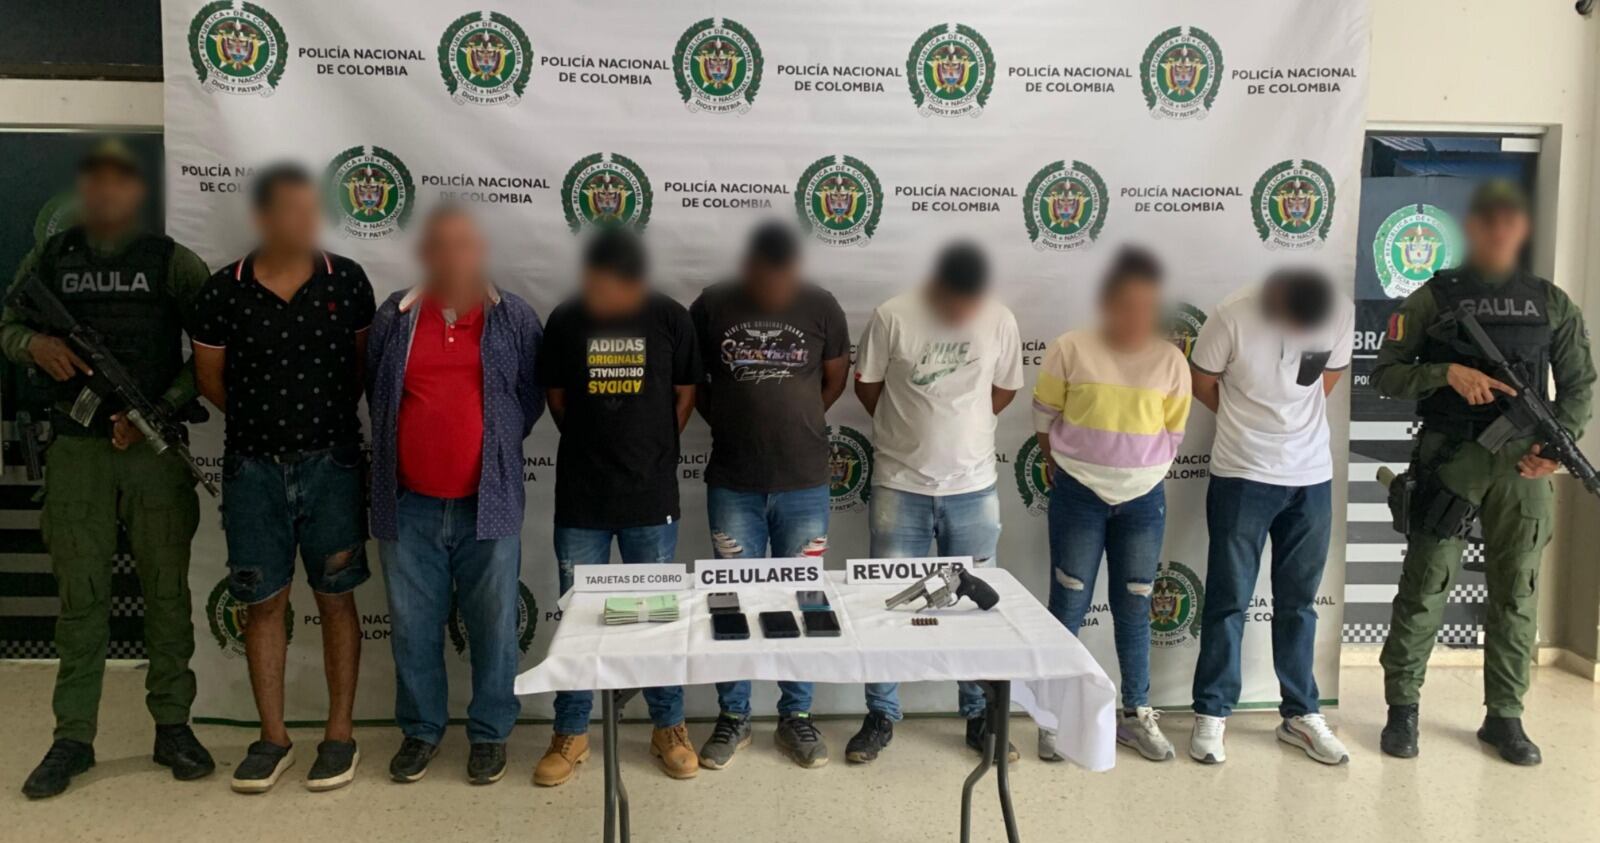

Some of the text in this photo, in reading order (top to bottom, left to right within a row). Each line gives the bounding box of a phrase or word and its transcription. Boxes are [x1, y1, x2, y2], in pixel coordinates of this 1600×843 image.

[200, 12, 225, 50] REPUBLICA
[252, 17, 276, 57] COLOMBIA
[450, 24, 474, 61] REPUBLICA
[500, 26, 521, 64] COLOMBIA
[299, 45, 425, 60] POLICÍA NACIONAL
[684, 32, 707, 70] REPUBLICA
[731, 34, 752, 72] COLOMBIA
[917, 37, 939, 75] REPUBLICA
[964, 38, 984, 76] COLOMBIA
[541, 54, 669, 70] POLICÍA NACIONAL
[1151, 41, 1174, 78] REPUBLICA
[1197, 41, 1213, 79] COLOMBIA
[317, 64, 408, 76] DE COLOMBIA
[778, 62, 901, 77] POLICÍA NACIONAL
[1009, 65, 1132, 77] POLICÍA NACIONAL
[1232, 66, 1356, 79] POLICÍA NACIONAL
[559, 72, 652, 85] DE COLOMBIA
[795, 81, 884, 92] DE COLOMBIA
[1026, 82, 1114, 92] DE COLOMBIA
[1248, 83, 1340, 94] DE COLOMBIA
[182, 163, 228, 176] POLICÍA
[200, 182, 214, 193] DE
[422, 174, 550, 188] POLICÍA NACIONAL
[665, 179, 789, 194] POLICÍA NACIONAL
[896, 182, 1017, 197] POLICÍA NACIONAL
[1121, 184, 1242, 197] POLICÍA NACIONAL
[461, 192, 532, 204] COLOMBIA
[682, 198, 771, 208] DE COLOMBIA
[912, 202, 1000, 211] DE COLOMBIA
[1135, 202, 1224, 212] DE COLOMBIA
[62, 271, 150, 293] GAULA
[1459, 298, 1540, 316] GAULA
[590, 339, 645, 352] ADIDAS
[588, 354, 644, 364] ORIGINALS
[922, 341, 971, 365] NIKE
[590, 367, 644, 378] ORIGINALS
[588, 380, 642, 394] ADIDAS
[683, 469, 700, 479] DE
[586, 575, 681, 584] TARJETAS DE COBRO
[701, 566, 819, 584] CELULARES
